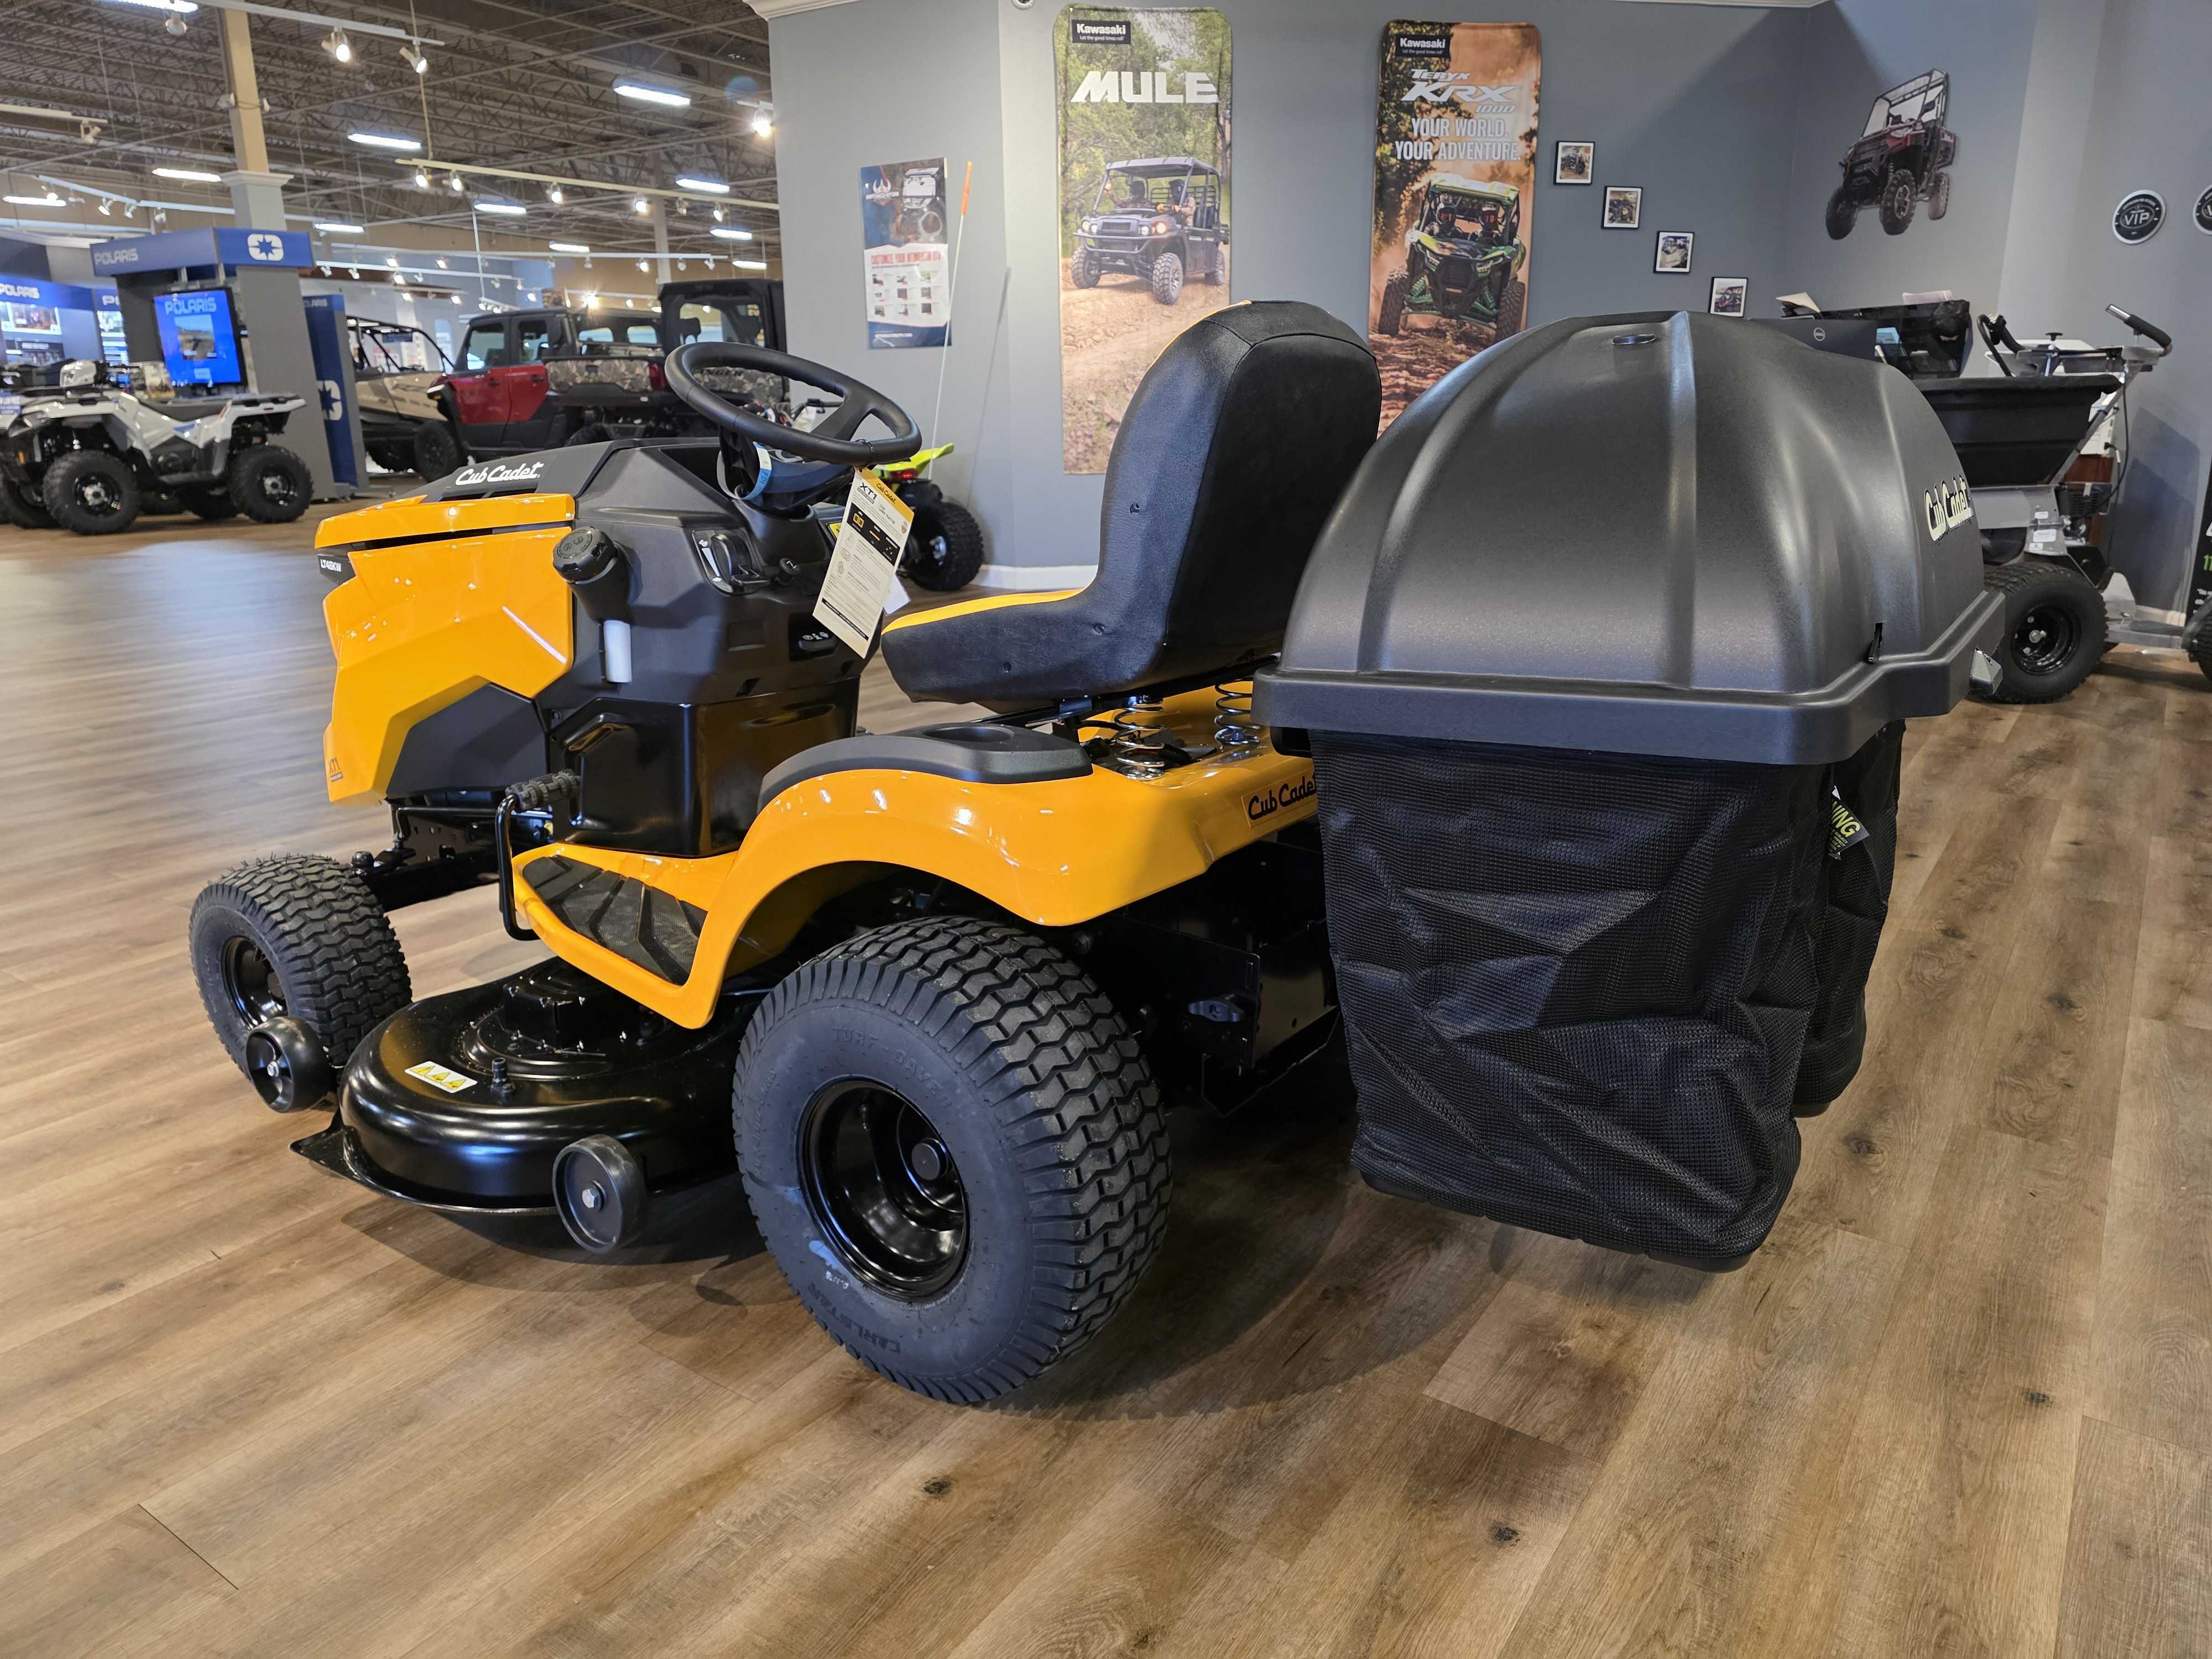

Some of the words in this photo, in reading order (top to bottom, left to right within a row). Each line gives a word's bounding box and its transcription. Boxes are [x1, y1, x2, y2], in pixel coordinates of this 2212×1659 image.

[1076, 23, 1126, 34] Kawasaki
[1400, 38, 1446, 48] Kawasaki
[1071, 71, 1220, 103] MULE
[1401, 81, 1520, 102] KRX
[1476, 105, 1516, 114] 1000
[1412, 118, 1450, 137] YOUR
[1455, 119, 1508, 137] WORLD.
[1395, 140, 1433, 160] YOUR
[1438, 142, 1521, 161] ADVENTURE.
[2124, 212, 2150, 226] VIP
[94, 248, 138, 265] POLARIS
[165, 298, 216, 315] POLARIS
[456, 467, 489, 486] Cub
[487, 462, 544, 482] Cadet
[859, 482, 877, 500] XT1
[877, 483, 885, 492] Cub
[884, 490, 896, 504] Cadet
[1924, 486, 1946, 541] Cub
[1942, 477, 1973, 529] Cadet
[1248, 790, 1277, 820] Cub
